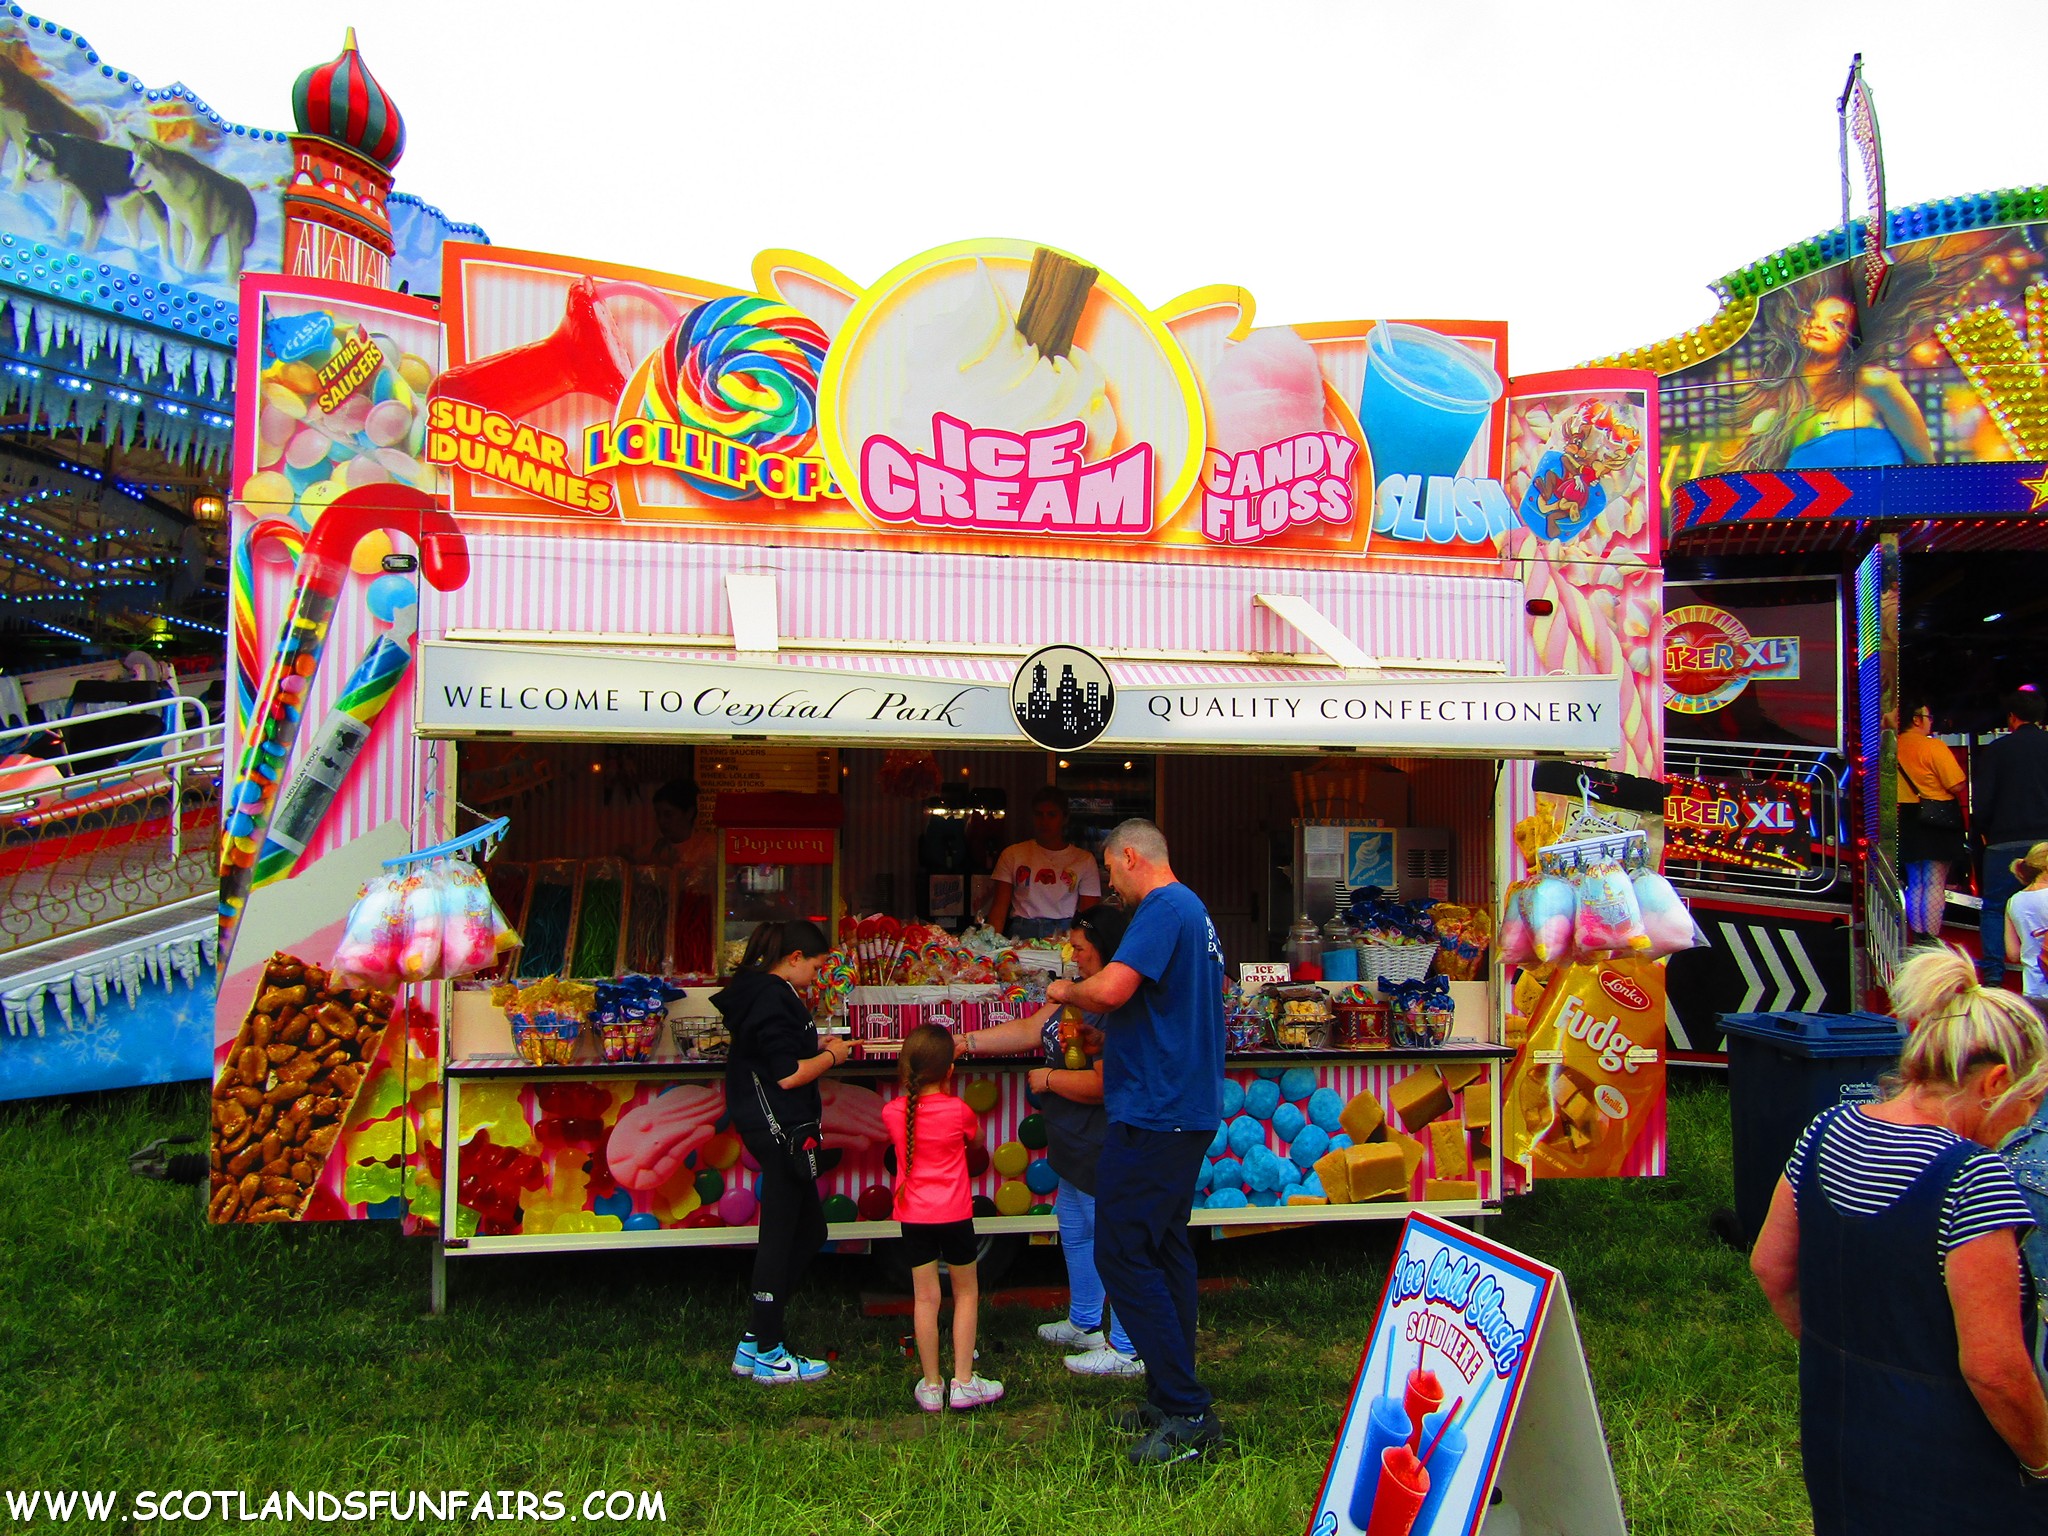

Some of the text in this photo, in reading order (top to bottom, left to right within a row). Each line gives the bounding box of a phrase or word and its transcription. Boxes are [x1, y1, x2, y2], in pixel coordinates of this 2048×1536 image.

[318, 341, 358, 386] FLYING
[320, 343, 381, 413] SAUCERS
[431, 400, 567, 470] SUGAR
[936, 416, 1082, 481] ICE
[430, 432, 611, 511] DUMMIES
[864, 439, 1148, 527] CREAM
[1204, 434, 1355, 496] CANDY
[1205, 478, 1349, 541] FLOSS
[1373, 473, 1521, 544] SLUSH
[1742, 639, 1786, 668] XL
[444, 685, 990, 727] WELCOME TO Central Park
[1148, 694, 1603, 724] QUALITY CONFECTIONERY
[305, 746, 321, 768] ROCK
[700, 748, 767, 757] FLYING SAUCERS
[286, 768, 308, 800] HOLIDAY
[737, 780, 766, 788] STICKS
[1747, 801, 1796, 829] XL
[730, 836, 825, 855] Popcorn
[1245, 975, 1286, 983] CREAM
[1255, 965, 1275, 975] ICE
[1603, 978, 1643, 1006] Lonka
[1555, 996, 1645, 1074] Fudge
[1601, 1090, 1623, 1115] Vanilla
[1393, 1247, 1525, 1379] Ice Cold Slush
[1406, 1309, 1484, 1385] SOLD HERE
